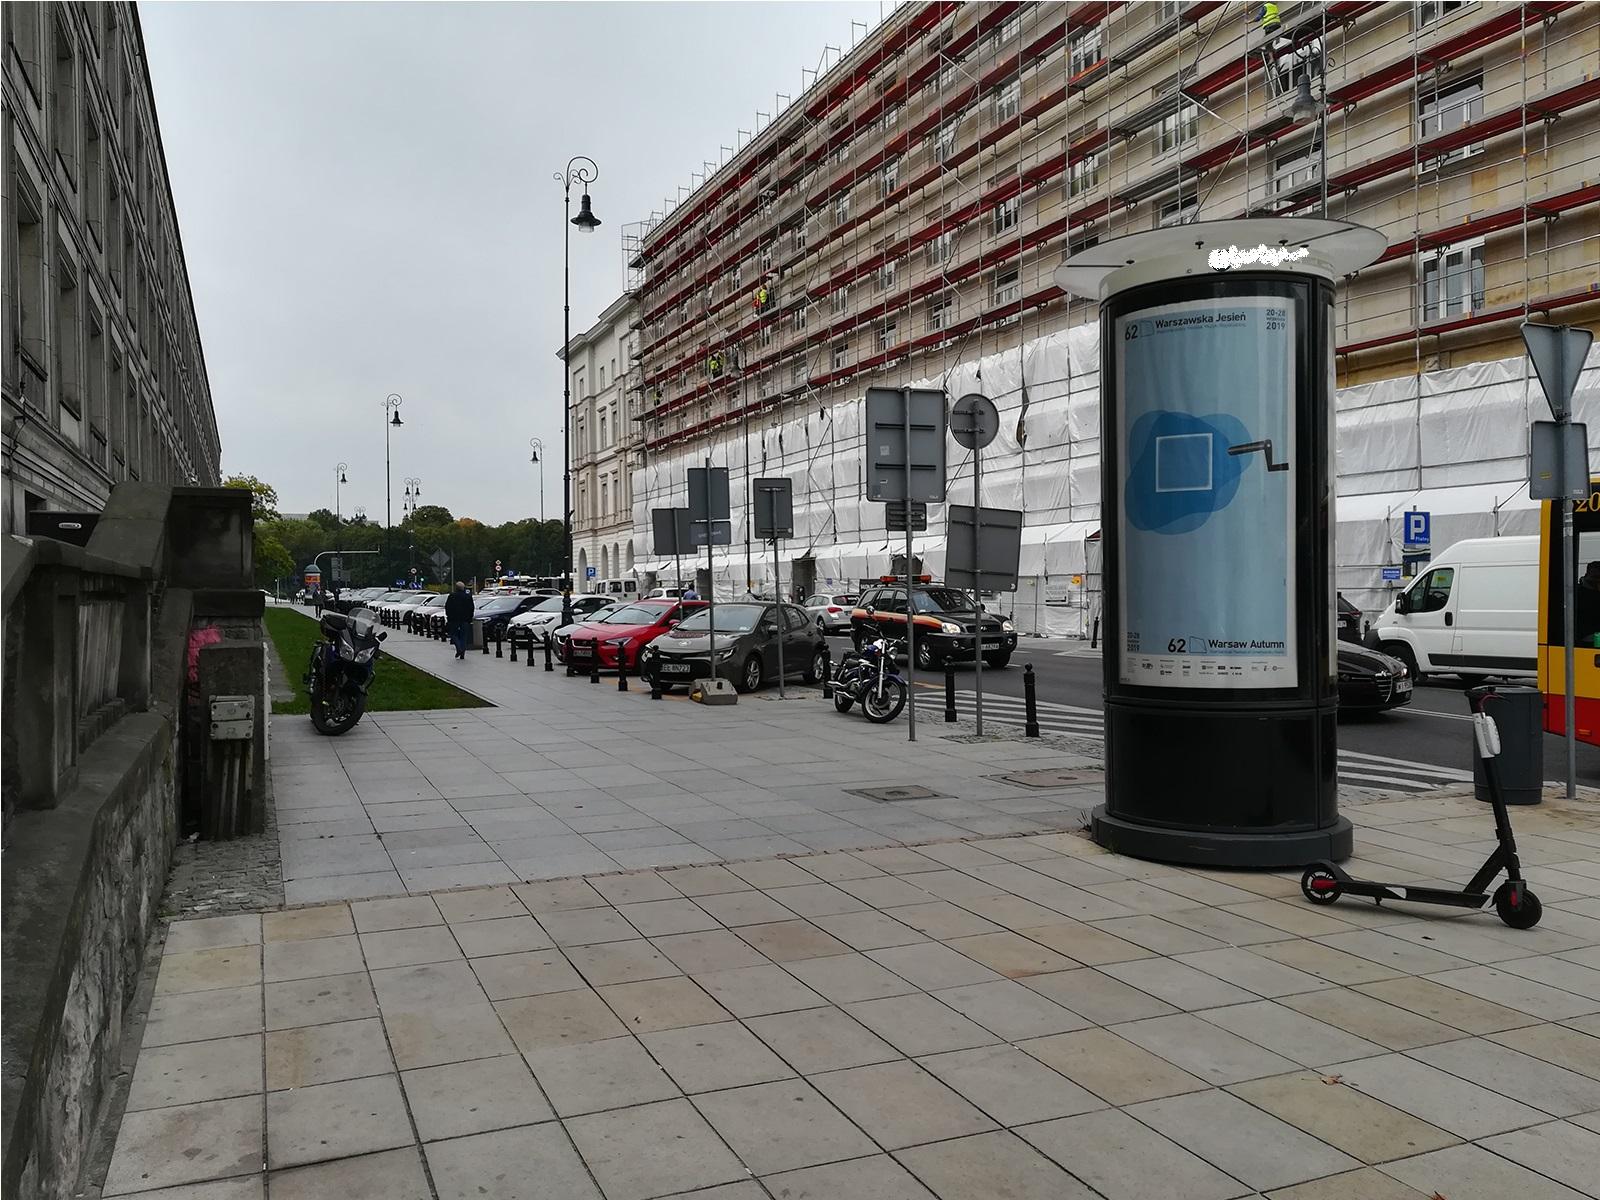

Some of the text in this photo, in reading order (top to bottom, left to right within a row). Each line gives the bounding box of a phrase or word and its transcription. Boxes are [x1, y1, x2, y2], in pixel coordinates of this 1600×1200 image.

[1155, 314, 1214, 329] Warszawska
[1216, 311, 1246, 322] Jesień
[1266, 309, 1286, 317] 20-28
[1125, 324, 1138, 341] 62
[1266, 321, 1286, 330] 2019
[1410, 515, 1425, 540] P
[1168, 638, 1186, 653] 62
[1208, 639, 1285, 649] Warsaw Autumn
